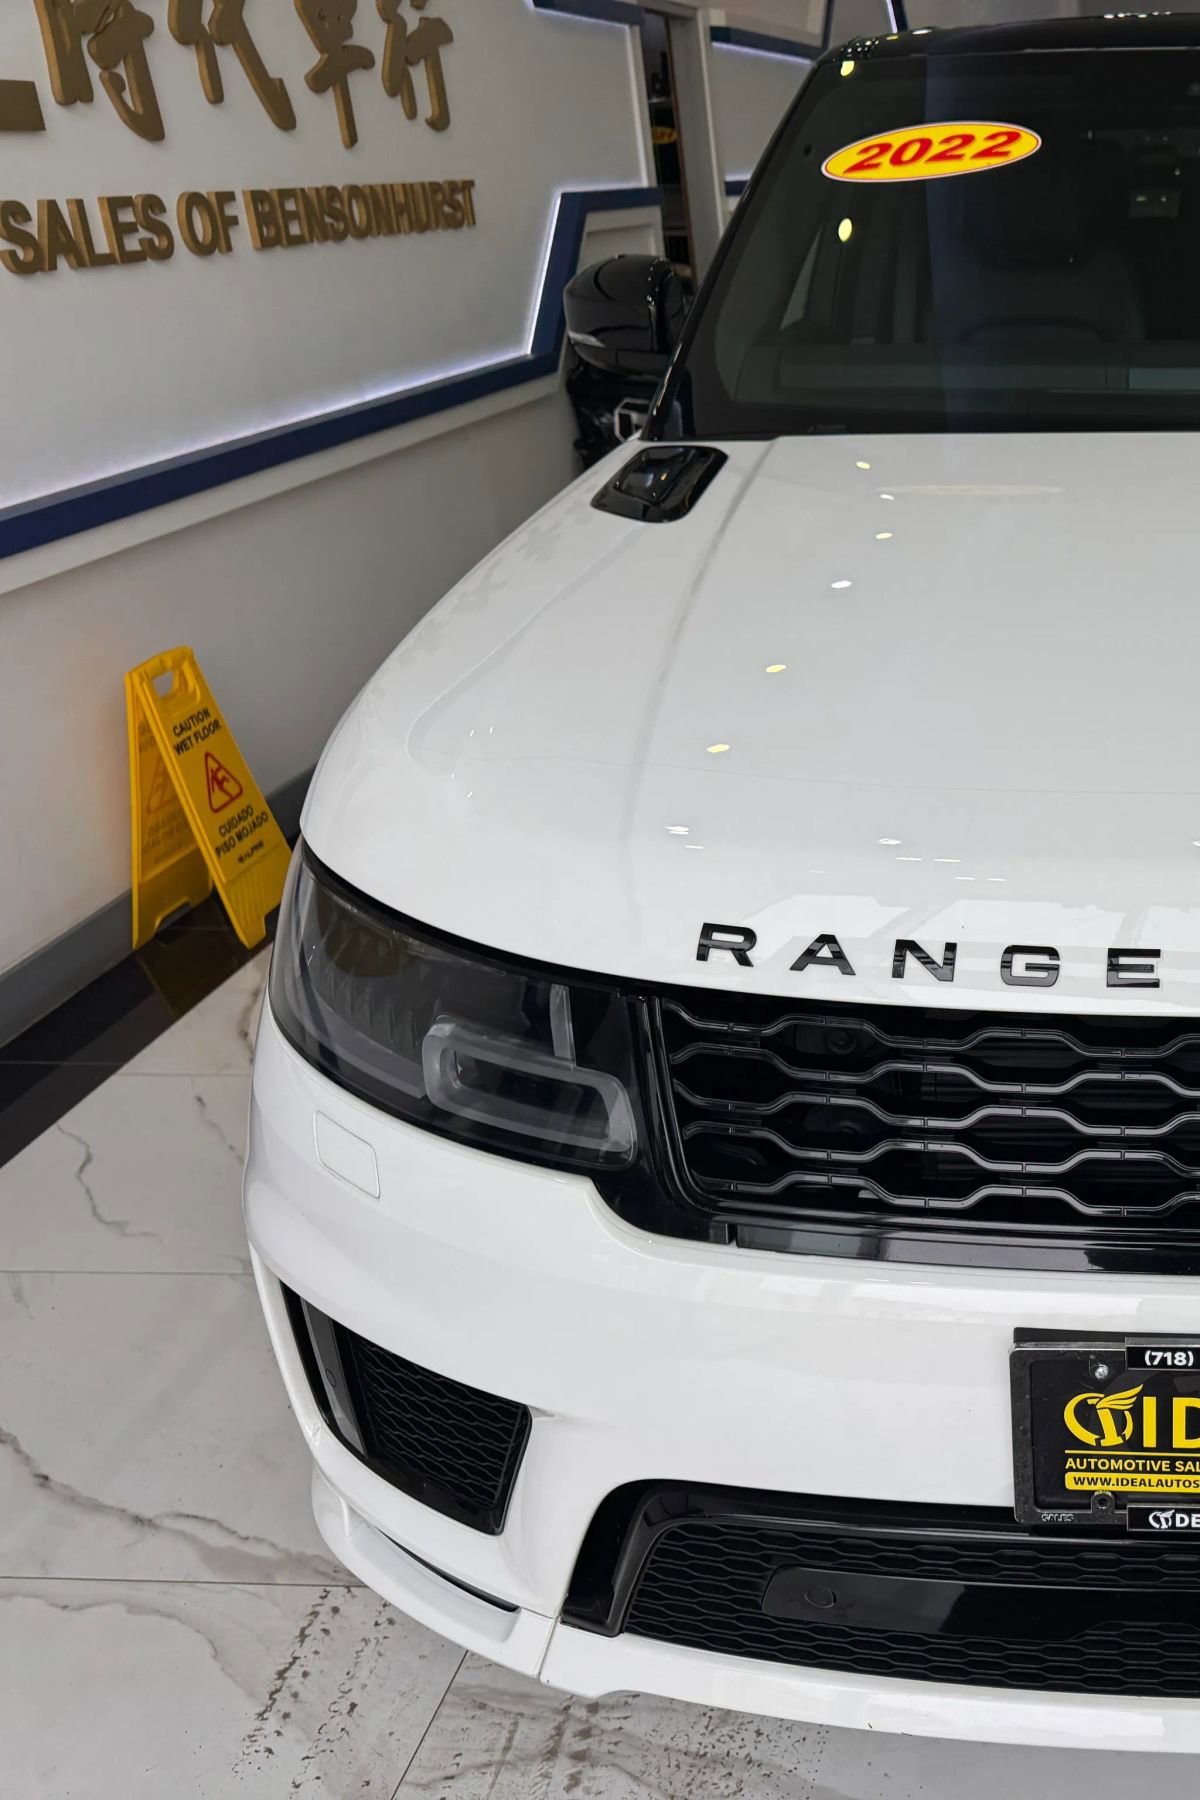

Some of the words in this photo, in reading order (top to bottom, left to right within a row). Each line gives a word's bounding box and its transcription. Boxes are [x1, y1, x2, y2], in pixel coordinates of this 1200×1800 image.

[843, 131, 1022, 174] 2022
[0, 193, 174, 274] SALES
[177, 190, 239, 257] OF
[243, 179, 476, 250] BENSONHURST
[172, 707, 211, 737] CAUTION
[174, 735, 194, 756] WET
[193, 718, 222, 744] FLOOR
[215, 835, 236, 858] PISO
[235, 811, 269, 842] MOJADO
[218, 804, 254, 837] CUIDADO
[696, 922, 1161, 988] RANGE
[1145, 1351, 1194, 1367] (718)
[1065, 1458, 1171, 1473] AUTOMOTIVE
